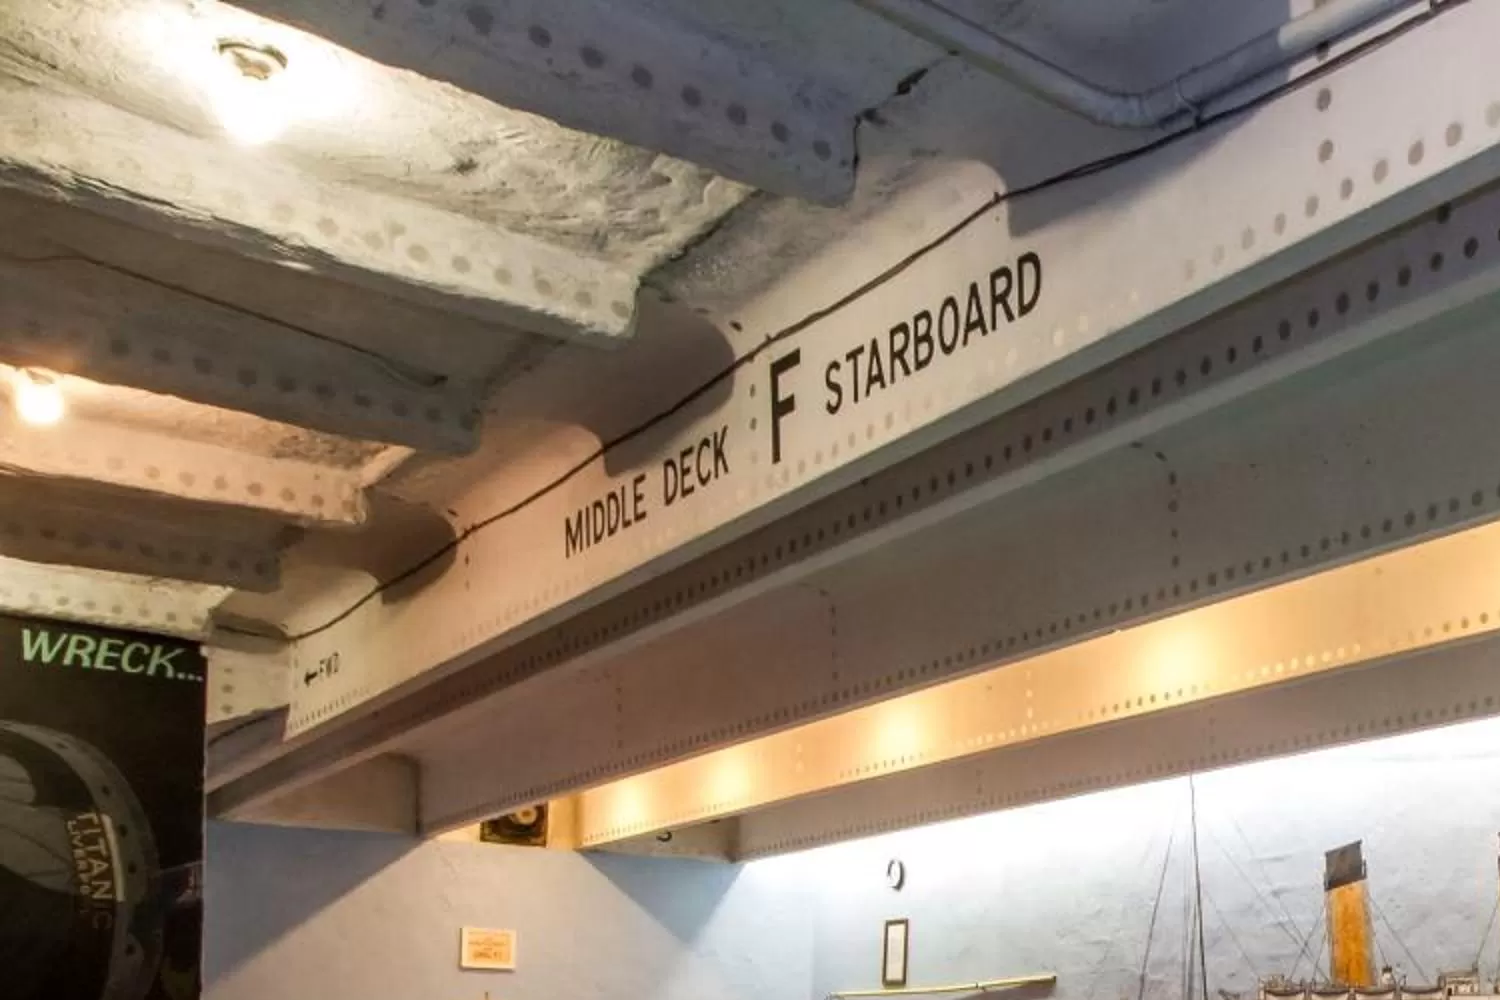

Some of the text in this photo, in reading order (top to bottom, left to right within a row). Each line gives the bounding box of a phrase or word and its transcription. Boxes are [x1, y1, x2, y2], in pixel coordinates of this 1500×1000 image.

[565, 251, 1042, 558] MIDDLE DECK F STARBOARD
[76, 812, 113, 929] TITANIC
